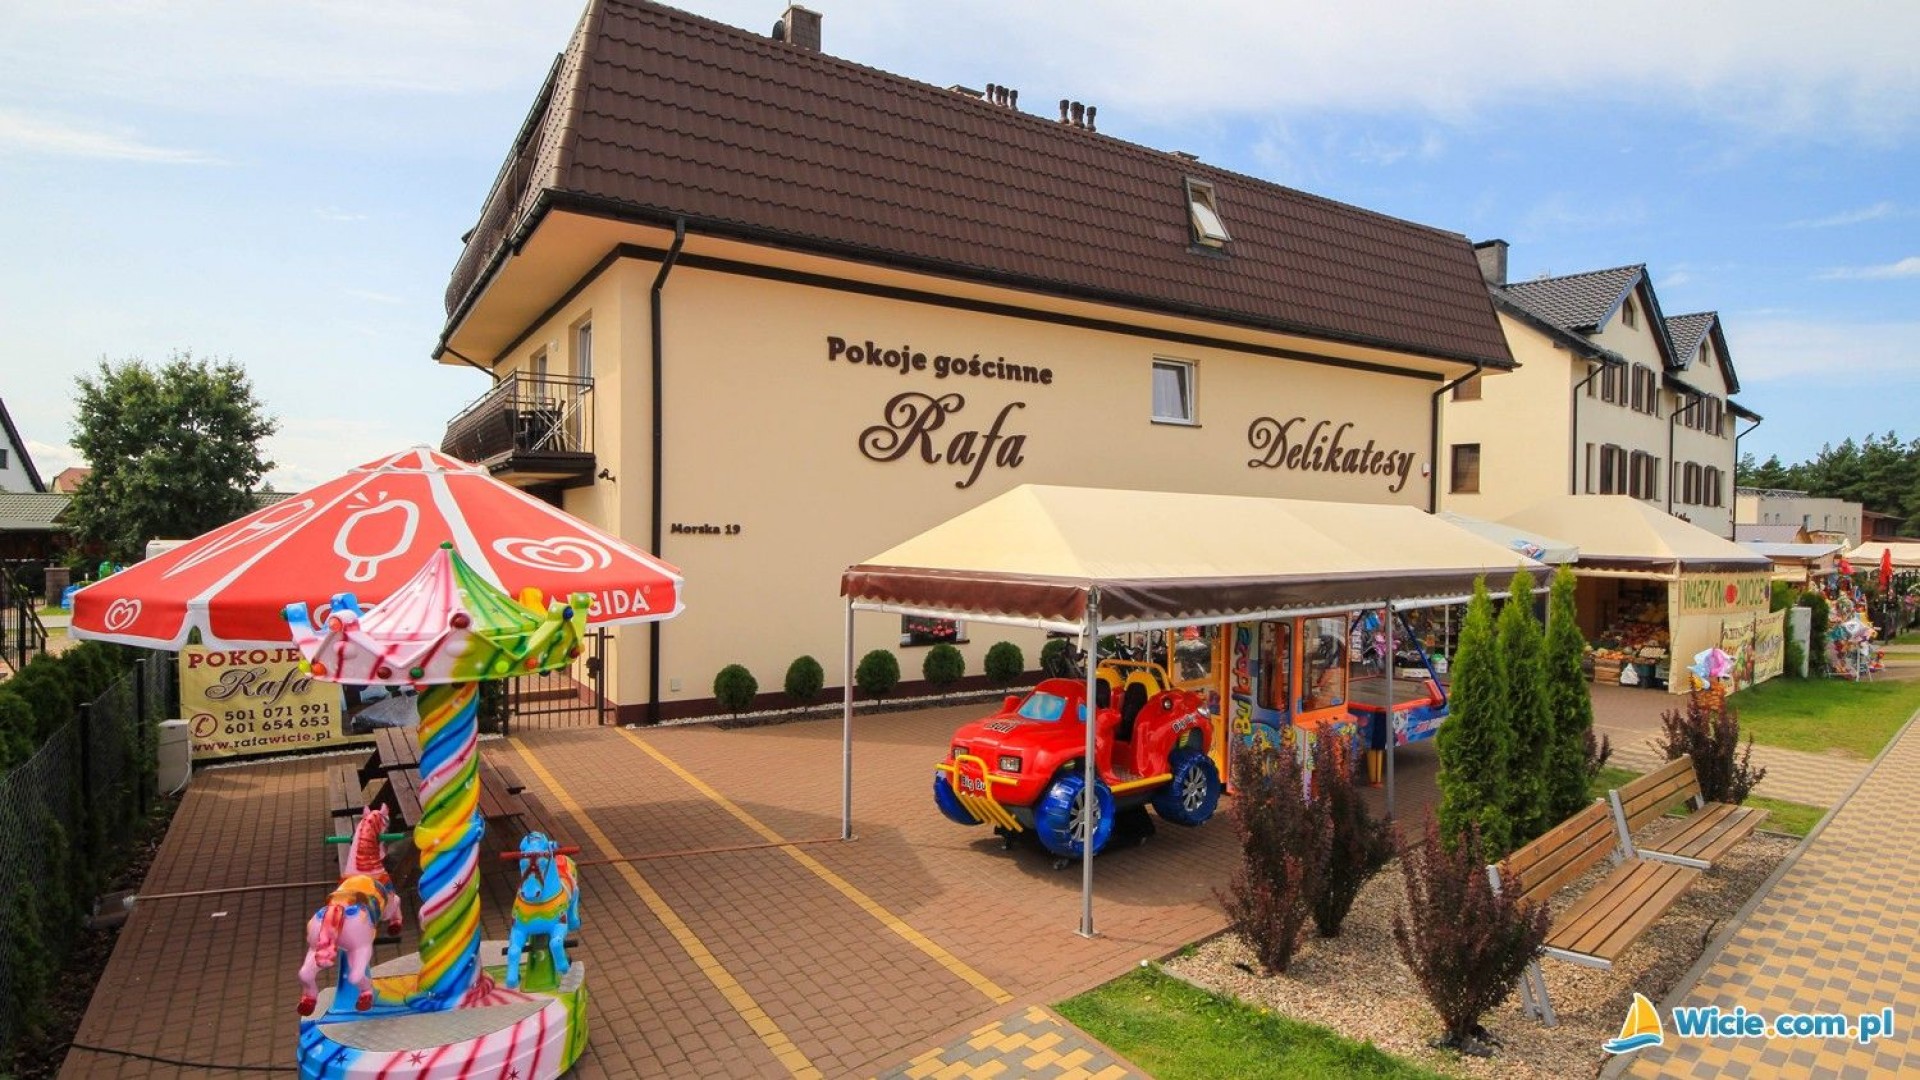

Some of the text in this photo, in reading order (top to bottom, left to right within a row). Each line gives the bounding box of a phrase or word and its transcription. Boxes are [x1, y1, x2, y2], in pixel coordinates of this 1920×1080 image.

[827, 336, 1053, 384] Pokoje gościnne
[858, 391, 1027, 489] Rafa
[1247, 416, 1416, 493] Delikatesy
[670, 523, 741, 535] Morska 19
[187, 649, 301, 669] POKOJE
[205, 667, 313, 706] Rafa
[224, 703, 330, 721] 501 071 991
[224, 715, 331, 735] 601 654 653
[192, 731, 331, 752] www.rafawicie.pl
